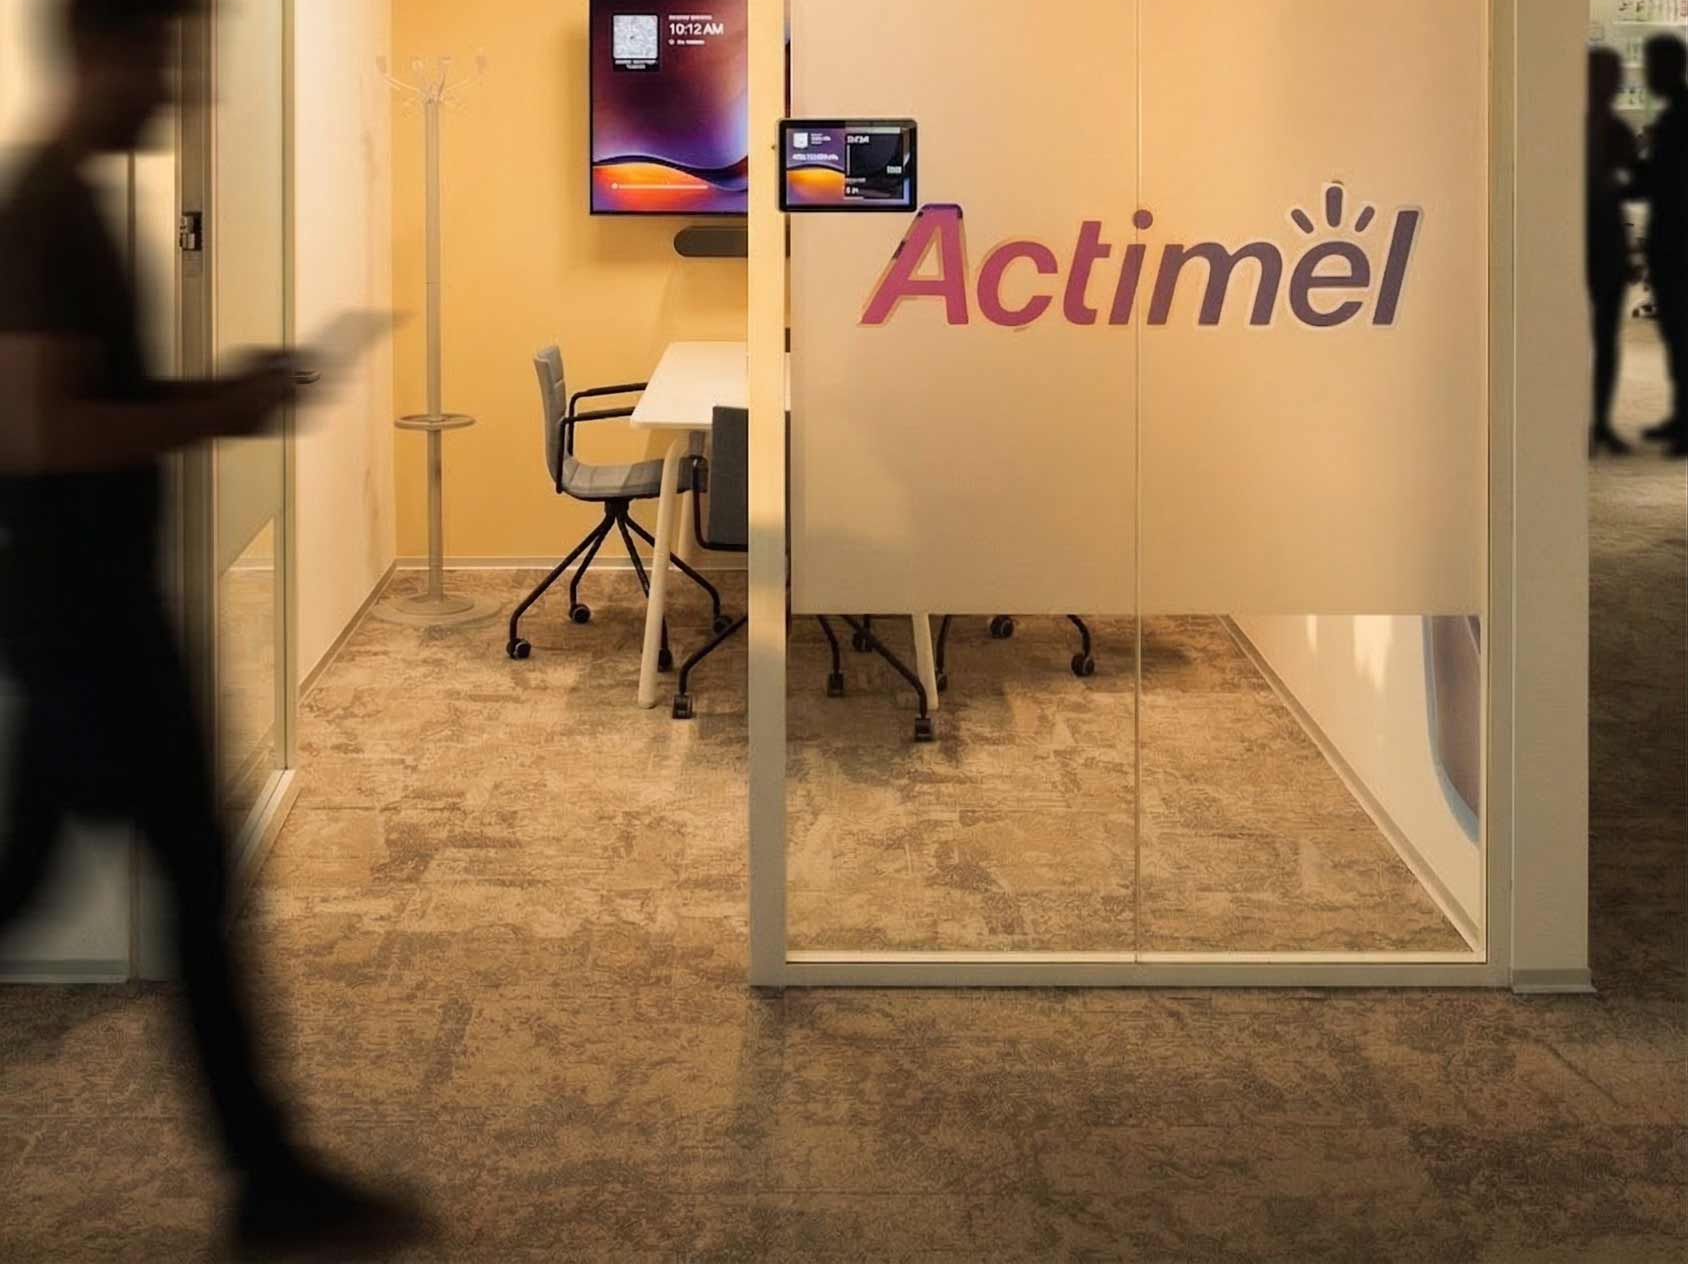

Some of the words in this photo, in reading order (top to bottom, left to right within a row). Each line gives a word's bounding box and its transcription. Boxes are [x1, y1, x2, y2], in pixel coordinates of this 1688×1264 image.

[669, 22, 702, 36] 10:12
[703, 23, 725, 36] AM
[861, 186, 1420, 327] Actimel
